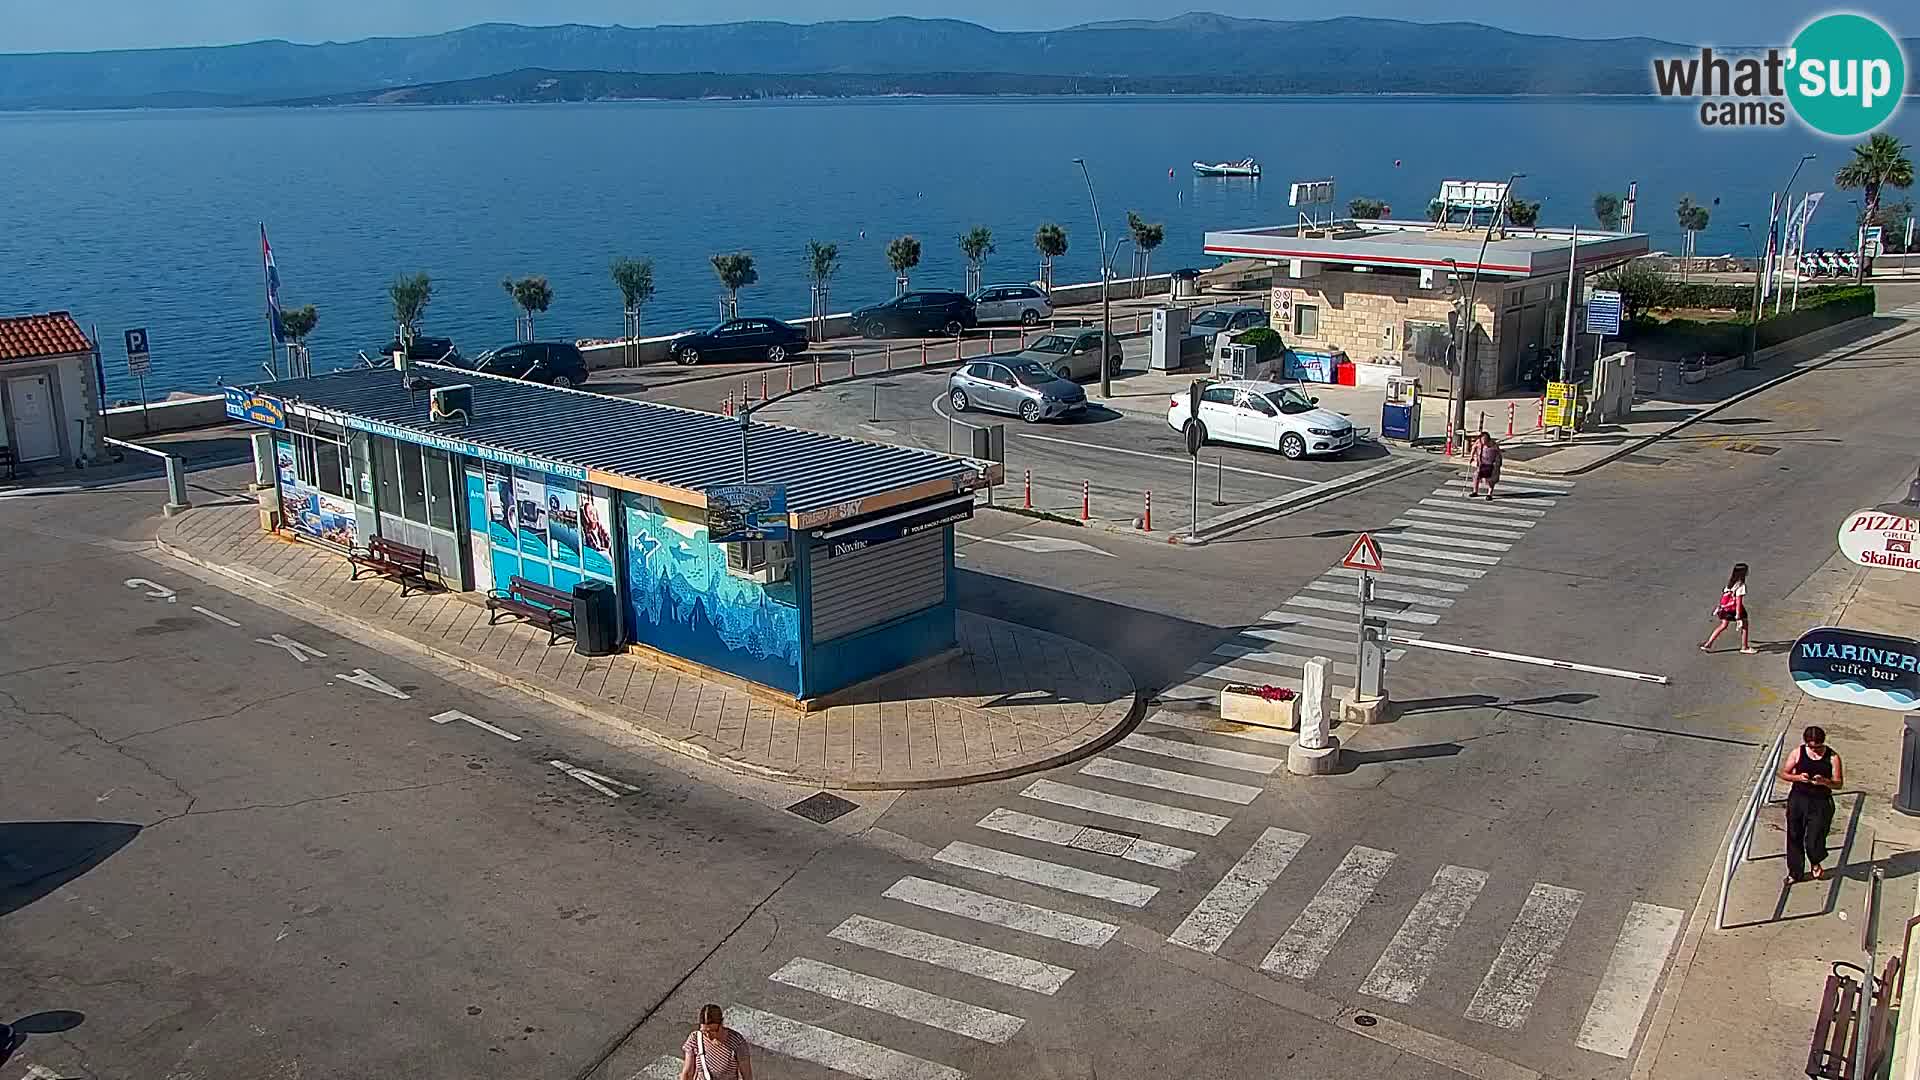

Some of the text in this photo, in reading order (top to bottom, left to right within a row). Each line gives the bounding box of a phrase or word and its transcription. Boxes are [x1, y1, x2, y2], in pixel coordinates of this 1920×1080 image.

[131, 332, 141, 350] P
[436, 437, 468, 453] POSTAJA
[478, 447, 493, 459] BUS
[494, 450, 526, 465] STATION
[529, 458, 554, 472] TICKET
[556, 463, 583, 478] OFFICE
[1849, 516, 1920, 533] PIZZE
[1882, 530, 1917, 541] GRILL
[1801, 643, 1920, 674] MARINER
[1830, 662, 1899, 681] caffe bar
